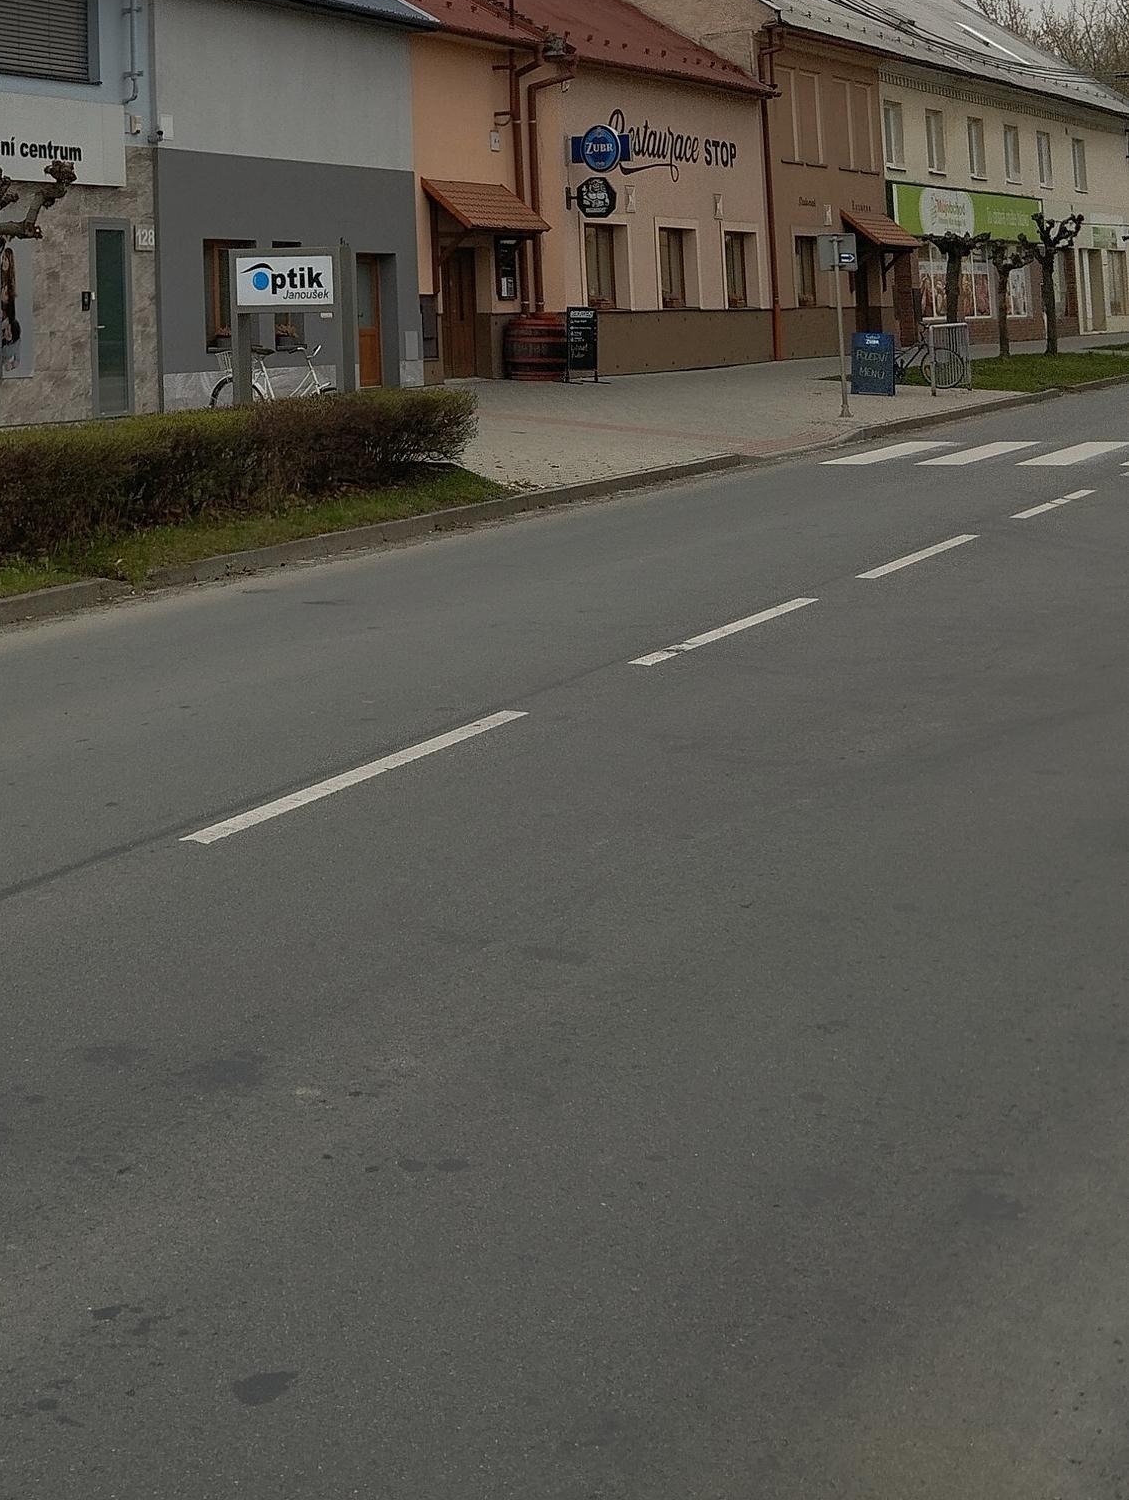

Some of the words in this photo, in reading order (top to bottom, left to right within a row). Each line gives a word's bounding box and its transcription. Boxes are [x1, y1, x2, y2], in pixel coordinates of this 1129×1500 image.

[19, 140, 83, 162] centrum
[703, 138, 737, 168] STOP
[282, 289, 330, 300] Janoušek
